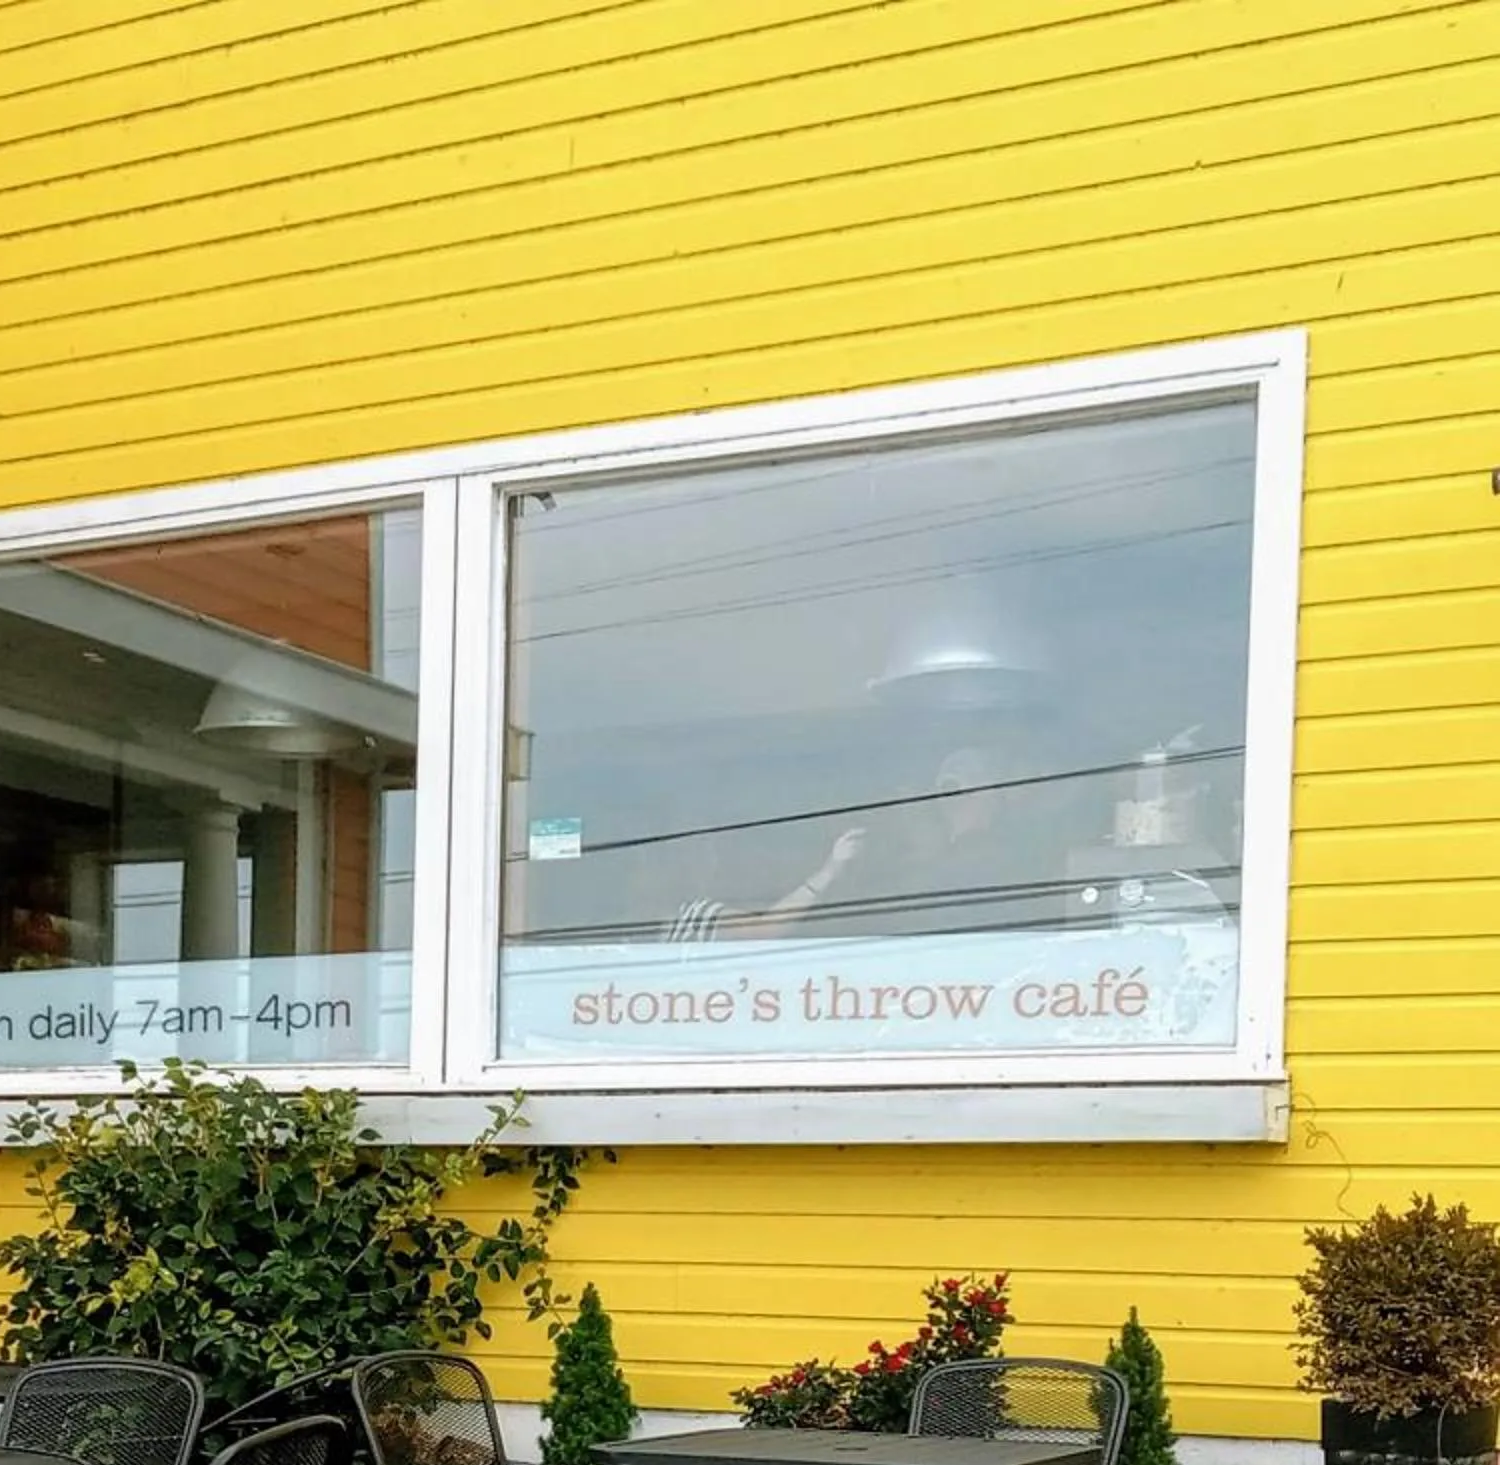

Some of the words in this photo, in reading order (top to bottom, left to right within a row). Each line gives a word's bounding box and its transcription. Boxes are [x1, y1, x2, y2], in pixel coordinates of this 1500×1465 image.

[572, 977, 781, 1026] stone's
[801, 976, 993, 1021] throw
[1012, 967, 1150, 1019] café
[28, 1003, 120, 1045] daily
